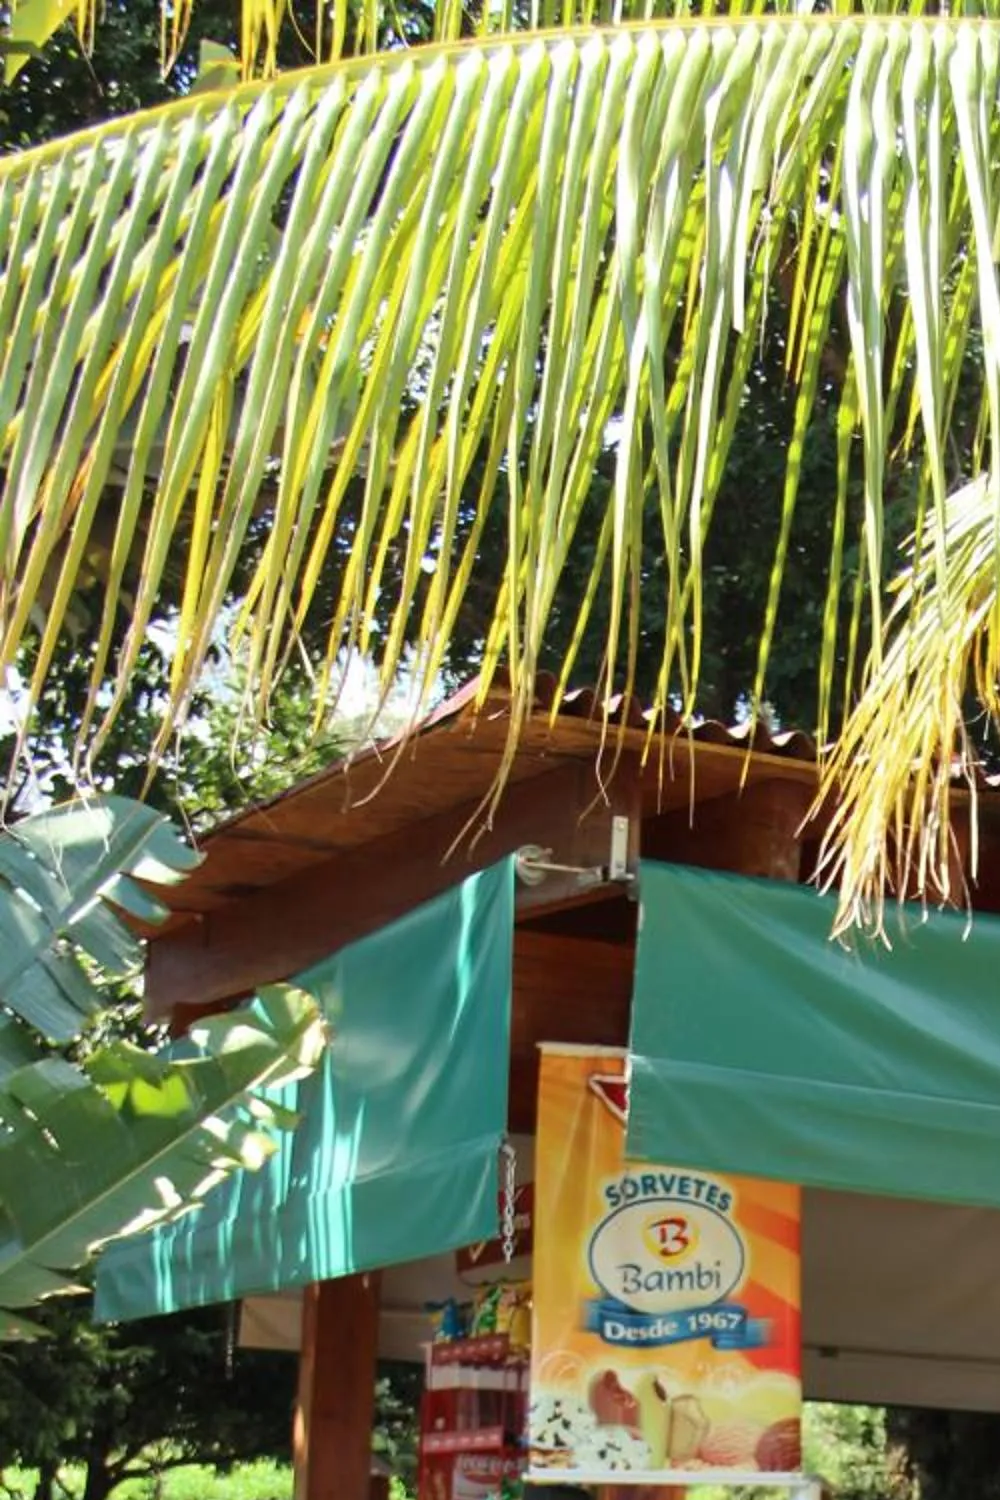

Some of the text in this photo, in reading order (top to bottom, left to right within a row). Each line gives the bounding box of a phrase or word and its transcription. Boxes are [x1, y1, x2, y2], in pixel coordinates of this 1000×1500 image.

[605, 1173, 732, 1211] SORVETES
[649, 1217, 689, 1257] B
[616, 1260, 722, 1294] Bambi
[603, 1311, 742, 1340] Desde 1967
